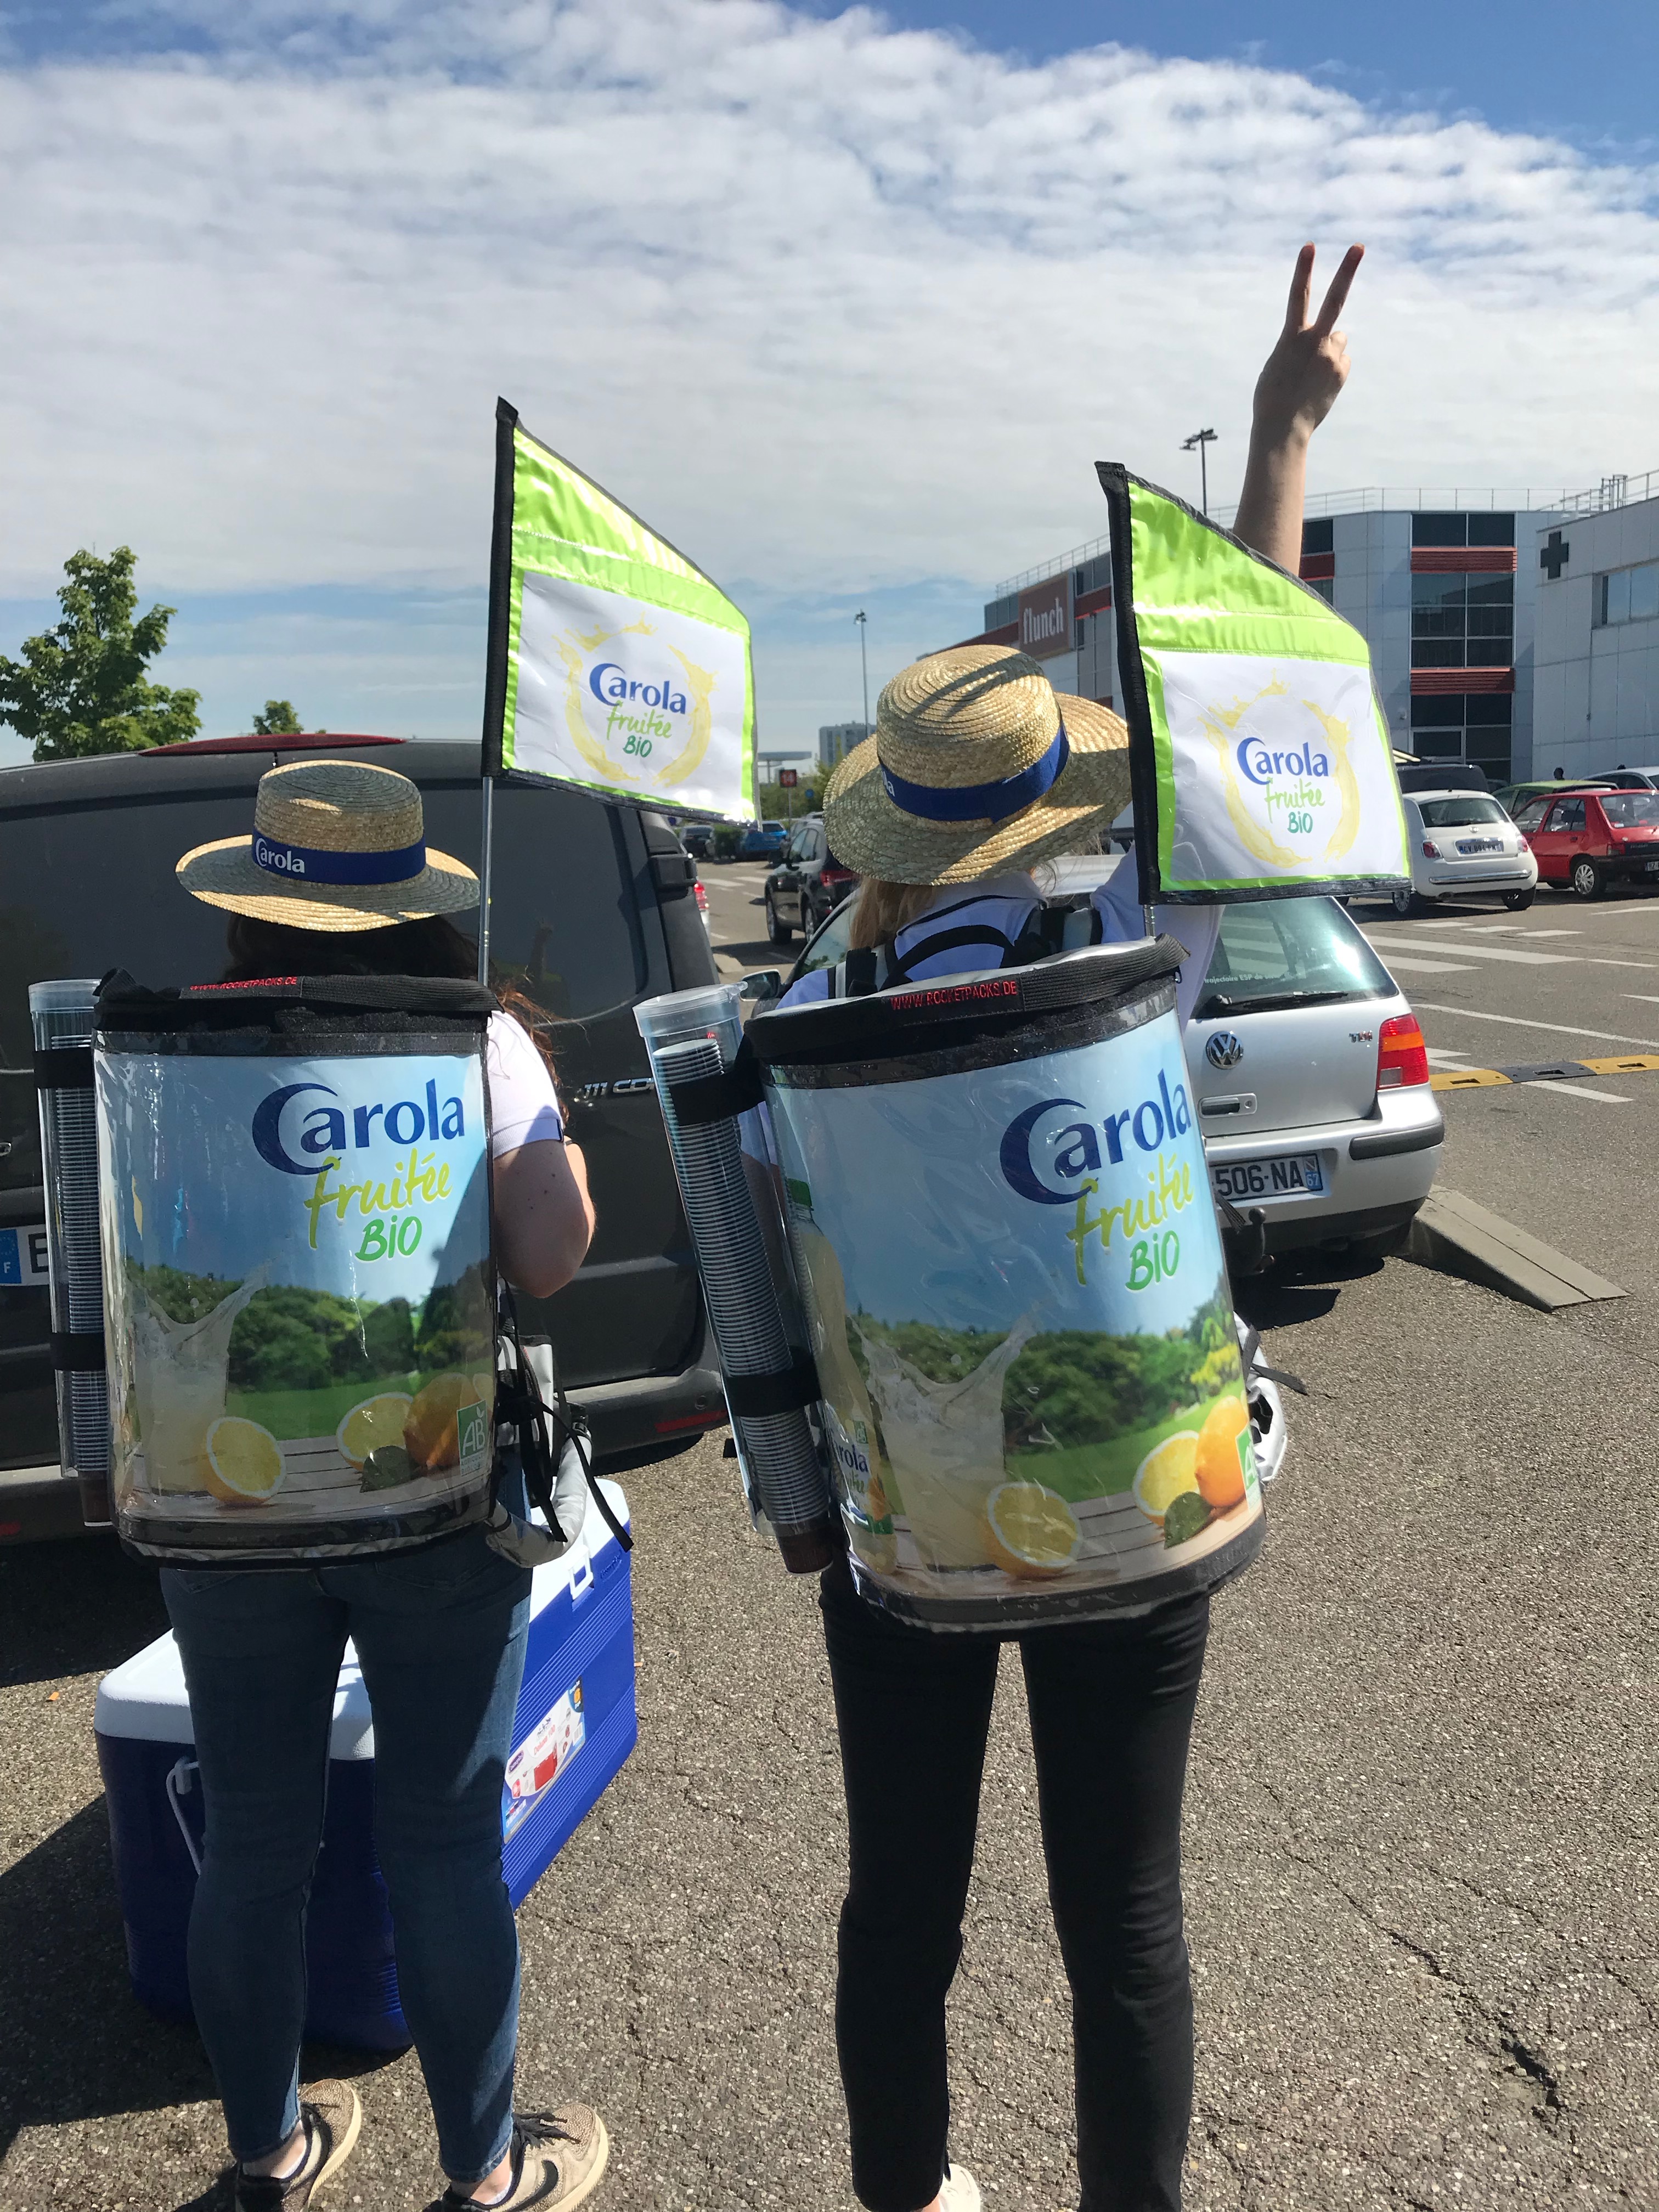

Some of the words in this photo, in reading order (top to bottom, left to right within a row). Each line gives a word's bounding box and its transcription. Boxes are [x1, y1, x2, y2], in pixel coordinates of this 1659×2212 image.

[1023, 597, 1064, 645] flunch
[589, 663, 686, 715] Carola
[606, 699, 673, 741] fruitée
[1237, 737, 1329, 785] Carola
[1264, 776, 1325, 824] fruitée
[256, 838, 305, 873] Carola
[890, 981, 1018, 1011] WWW.ROCKETPACKS.DE
[252, 1078, 465, 1175] Carola
[1000, 1068, 1192, 1205] Carola
[303, 1147, 453, 1250] fruitée
[1306, 1173, 1319, 1187] 67
[1066, 1152, 1195, 1286] fruitée
[3, 1262, 11, 1273] F
[28, 1232, 49, 1273] E
[462, 1419, 486, 1455] AB
